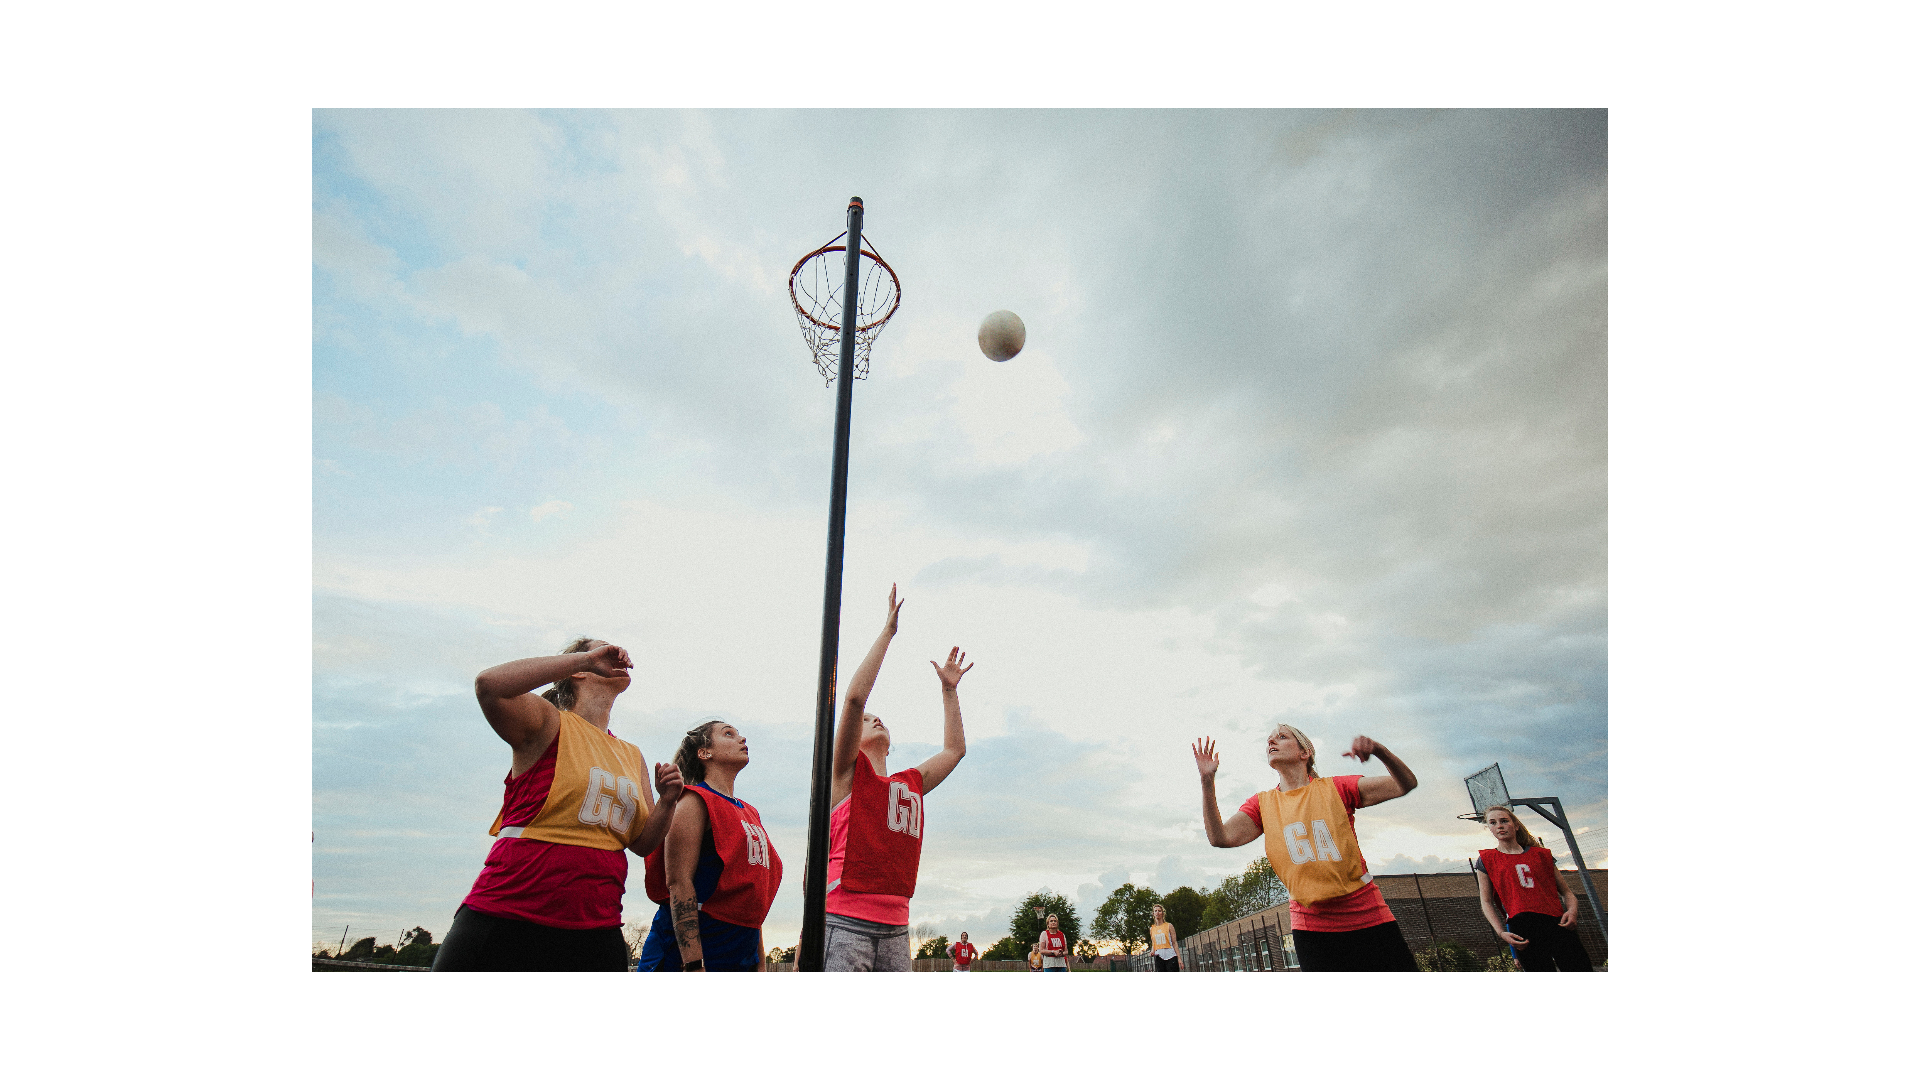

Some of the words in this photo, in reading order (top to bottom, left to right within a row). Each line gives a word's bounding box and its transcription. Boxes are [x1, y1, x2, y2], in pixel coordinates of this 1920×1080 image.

[578, 766, 640, 835] GS
[887, 781, 922, 839] GD
[1283, 819, 1343, 865] GA
[1515, 863, 1535, 889] C
